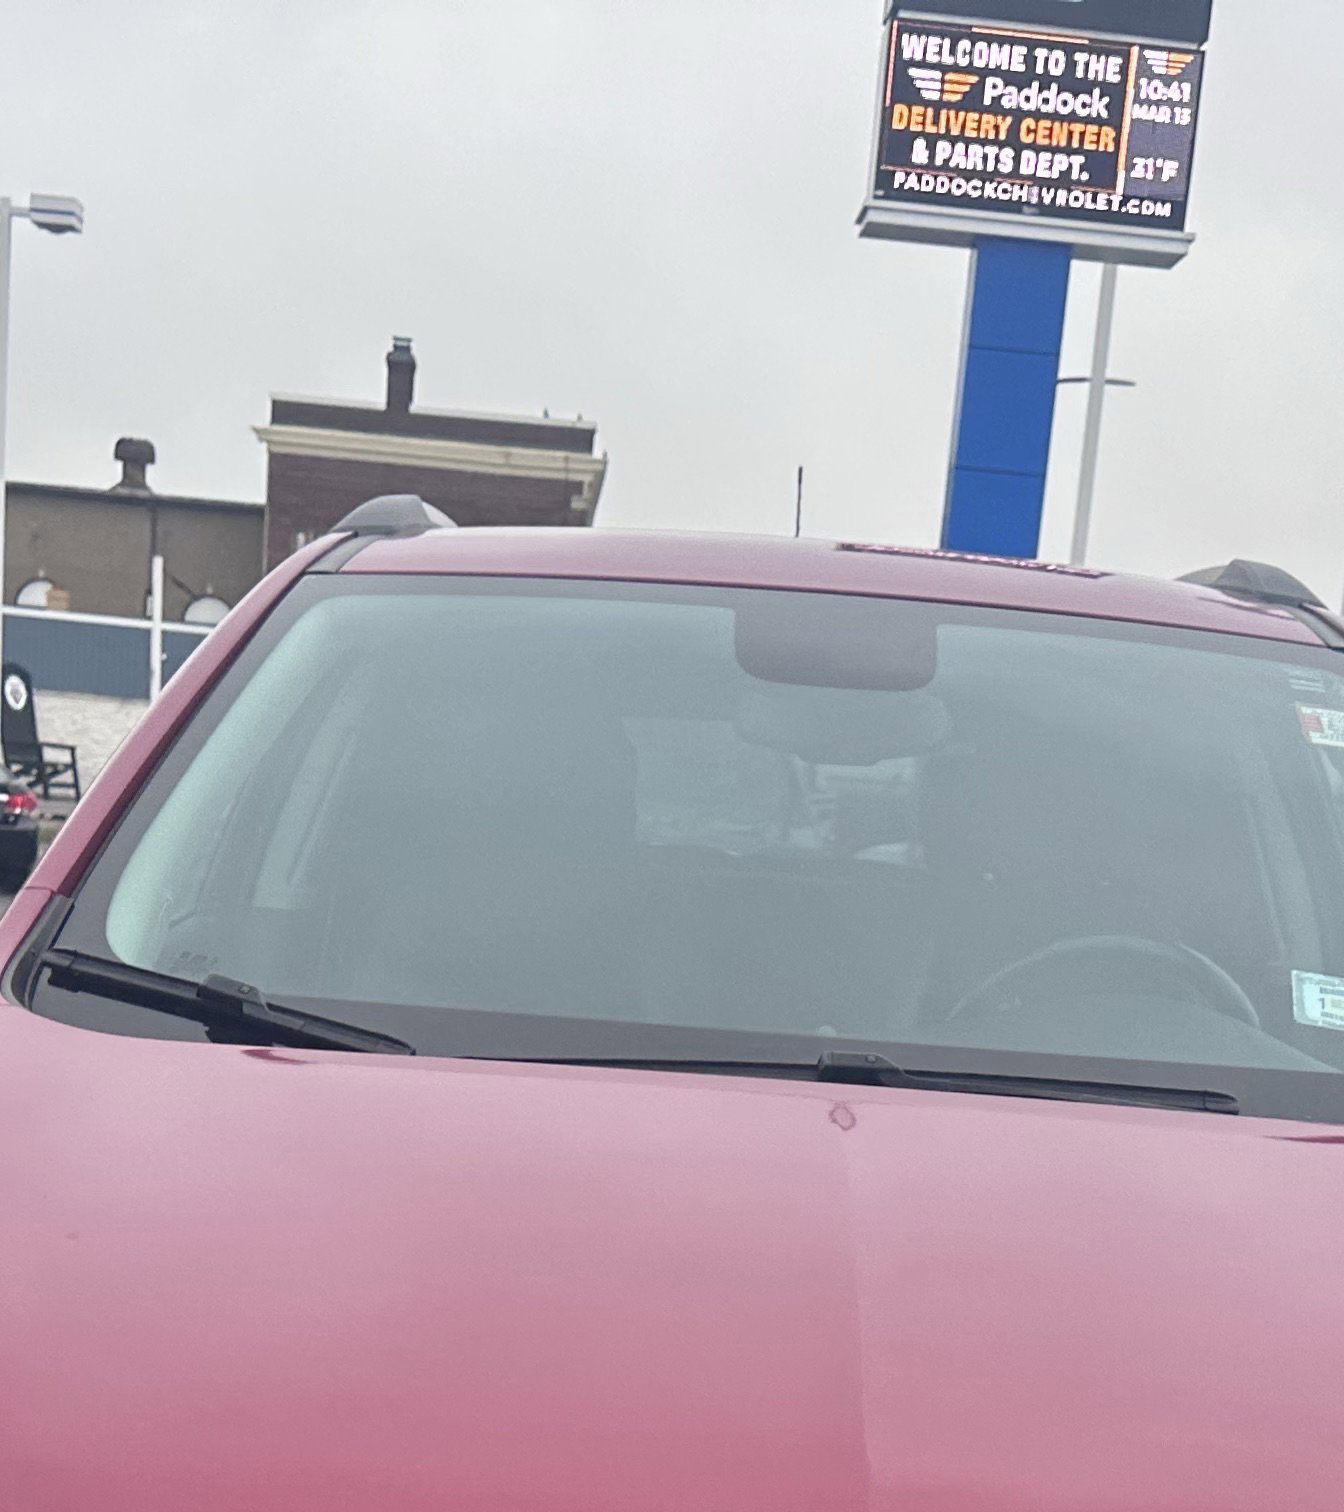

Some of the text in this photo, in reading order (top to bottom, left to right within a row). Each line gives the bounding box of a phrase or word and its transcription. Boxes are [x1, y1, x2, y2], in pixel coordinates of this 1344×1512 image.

[901, 32, 1123, 82] WELCOME TO THE
[982, 76, 1110, 118] Paddock
[1139, 78, 1192, 102] 10:41
[891, 104, 1115, 152] DELIVERY CENTER
[1131, 104, 1171, 124] MAR
[912, 138, 1090, 181] & PARTS DEPT.
